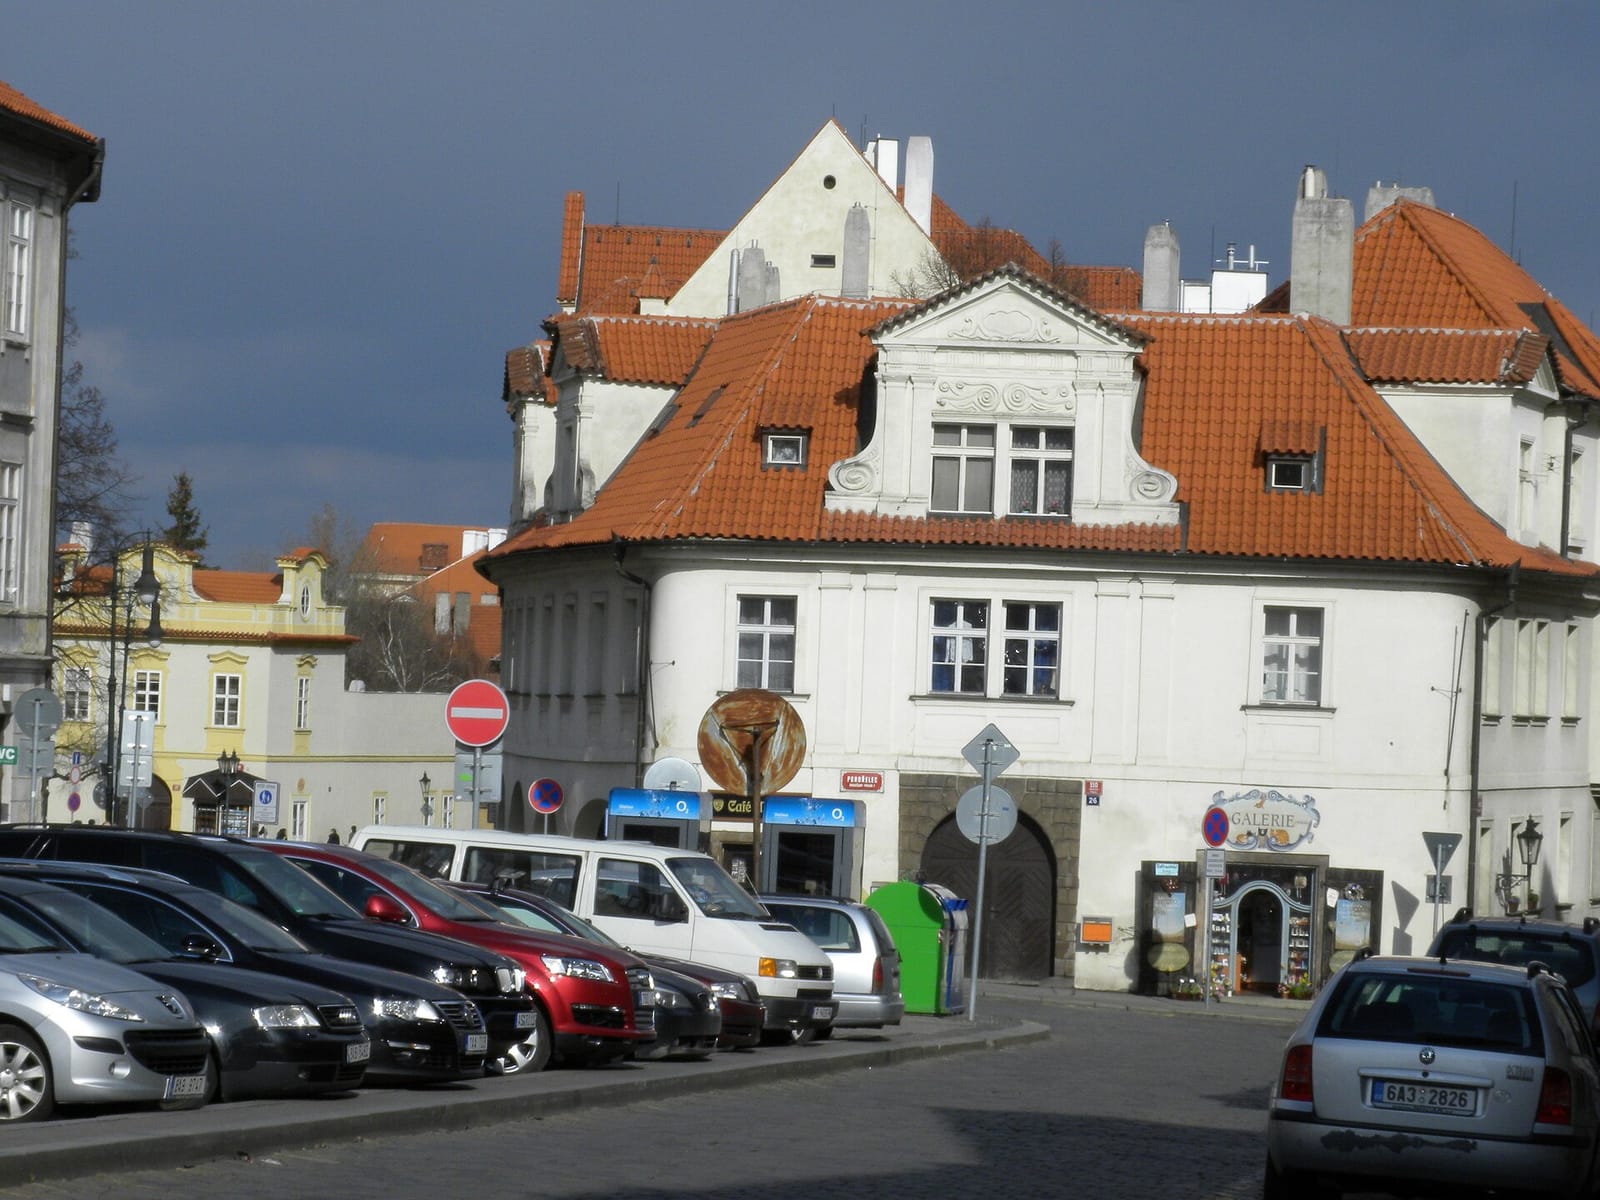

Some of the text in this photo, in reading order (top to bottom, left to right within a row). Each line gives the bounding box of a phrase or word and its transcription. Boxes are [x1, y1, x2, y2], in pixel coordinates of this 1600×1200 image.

[727, 799, 752, 813] Café
[1088, 796, 1098, 805] 26
[1231, 812, 1295, 828] GALERIE
[1386, 1085, 1468, 1108] 6A3 2826
